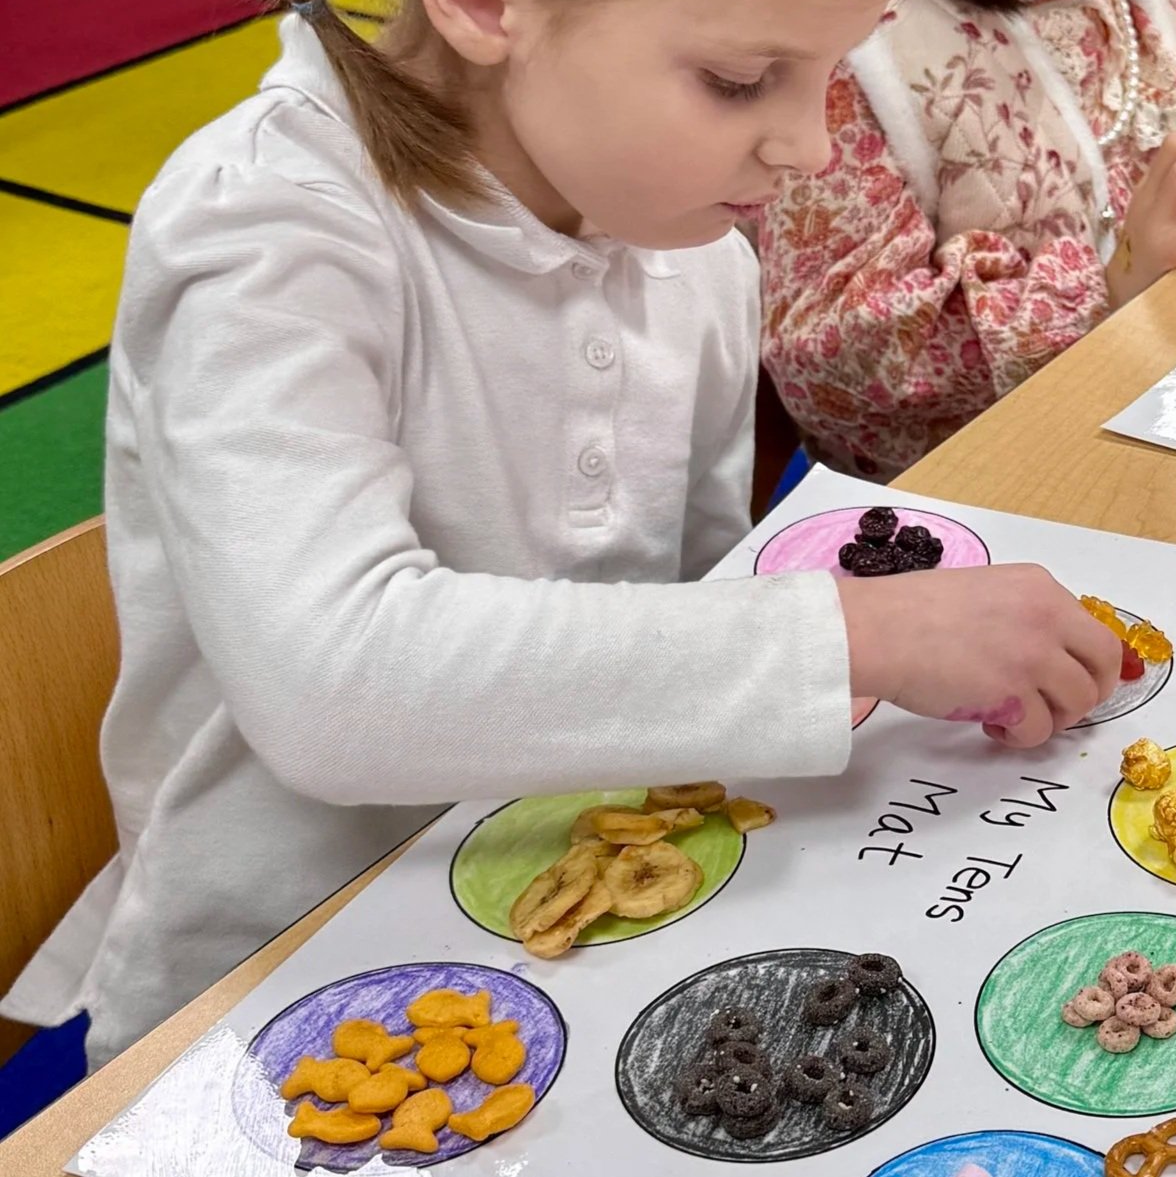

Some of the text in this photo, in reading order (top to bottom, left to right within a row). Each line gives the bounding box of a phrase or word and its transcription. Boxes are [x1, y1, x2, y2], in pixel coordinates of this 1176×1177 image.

[858, 778, 959, 866] Mat
[925, 776, 1070, 923] My Tens
